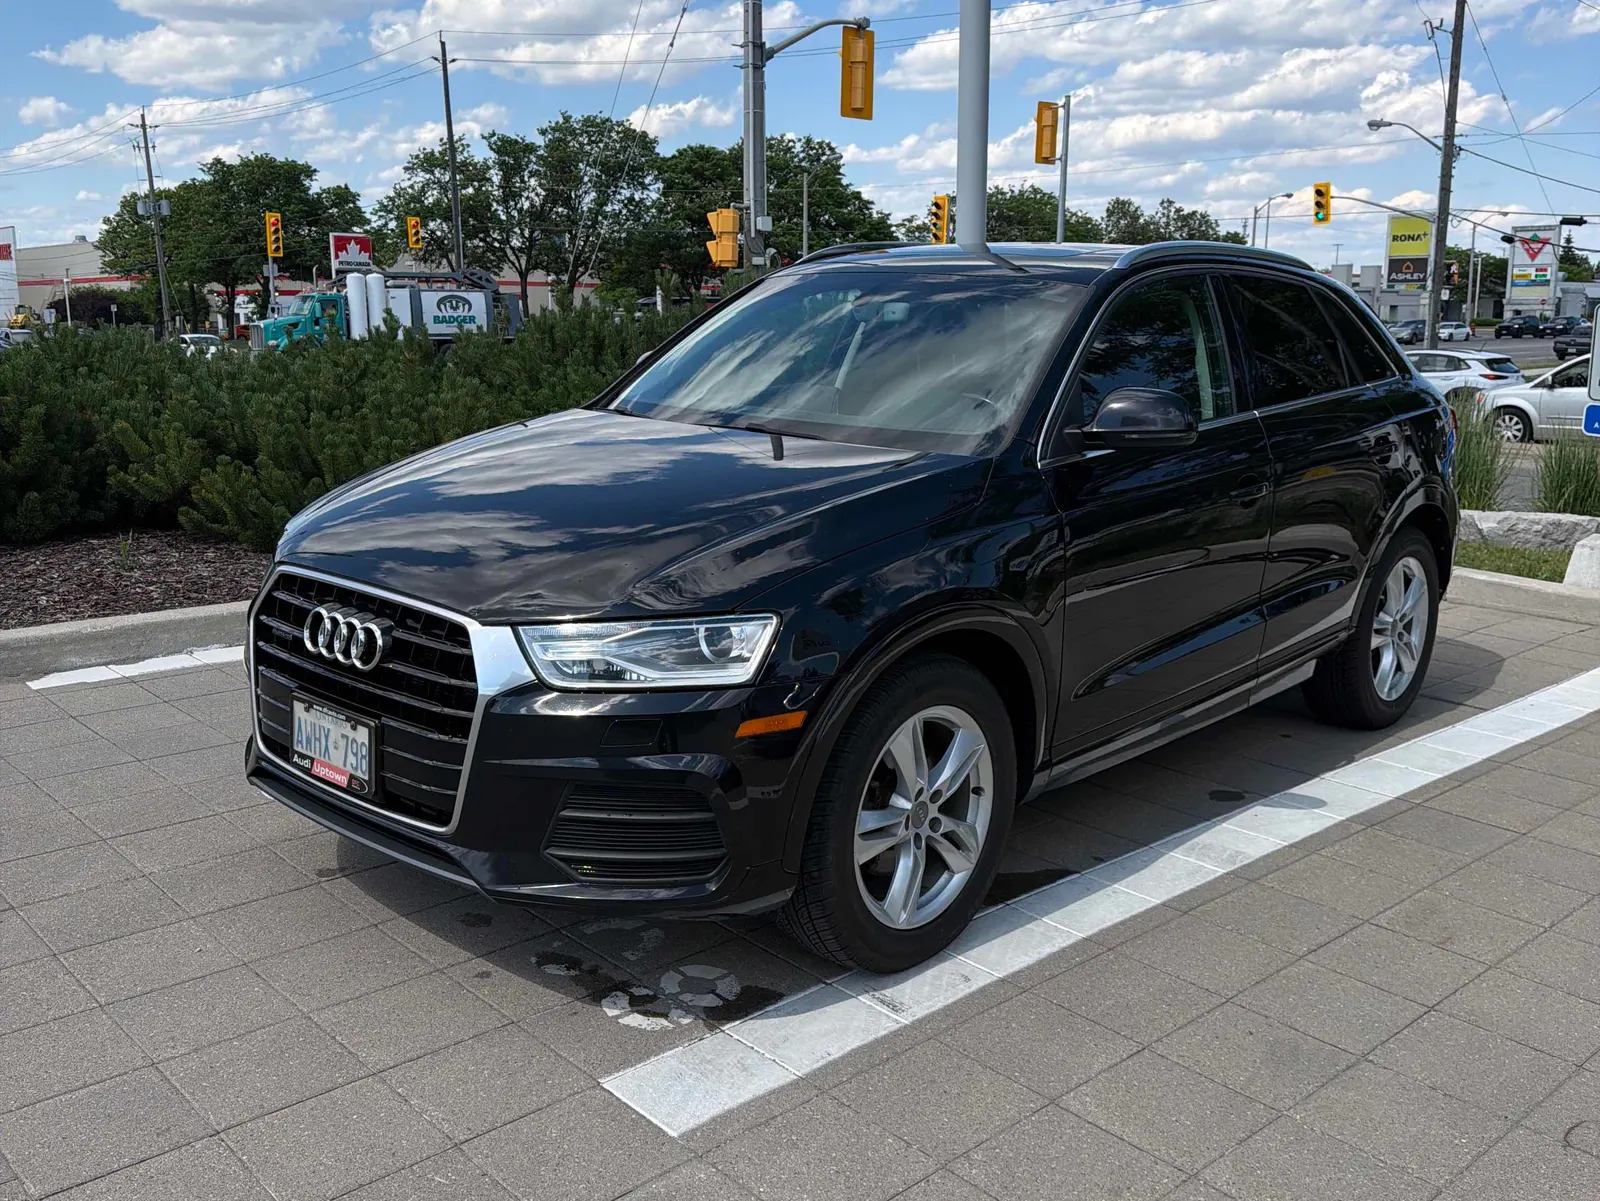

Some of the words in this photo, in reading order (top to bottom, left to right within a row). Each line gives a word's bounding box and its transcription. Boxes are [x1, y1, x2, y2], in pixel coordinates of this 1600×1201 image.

[1390, 272, 1425, 280] ASHLEY
[432, 315, 476, 325] BADGER
[296, 716, 331, 762] AWHX
[340, 733, 368, 777] 798
[293, 754, 311, 768] Audi
[314, 762, 347, 785] Uptown
